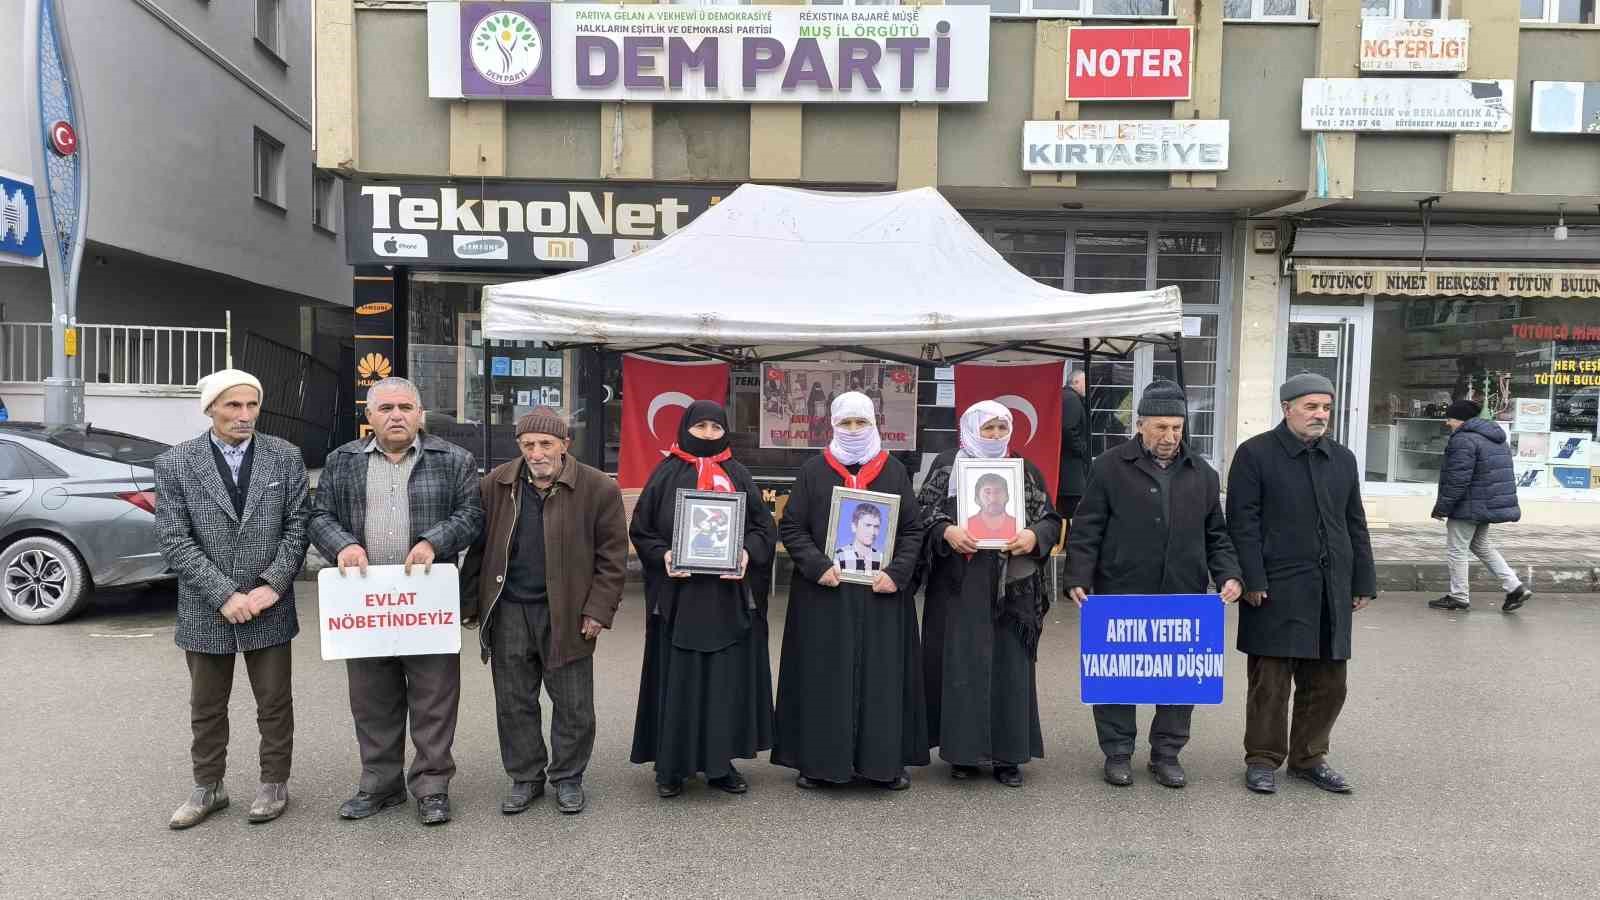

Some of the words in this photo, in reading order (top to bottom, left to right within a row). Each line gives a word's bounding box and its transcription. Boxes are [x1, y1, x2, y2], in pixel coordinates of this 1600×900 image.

[615, 11, 645, 20] GELAN
[576, 24, 629, 33] HALKLARIN
[631, 23, 666, 35] EŞİTLİK
[668, 25, 679, 33] VE
[681, 23, 733, 34] DEMOKRASİ
[736, 23, 772, 34] PARTİSİ
[799, 25, 832, 38] MUŞ
[836, 23, 849, 37] İL
[854, 23, 920, 37] ÖRGÜTÜ
[576, 35, 719, 89] DEM
[742, 20, 951, 90] PARTİ
[1076, 48, 1184, 78] NOTER
[486, 69, 503, 80] DEM
[1028, 140, 1225, 165] KIRTASİYE
[361, 185, 690, 237] TeknoNet
[1311, 271, 1374, 290] TÜTÜNCÜ
[1385, 271, 1428, 290] NİMET
[1507, 273, 1553, 291] TÜTÜN
[1554, 360, 1576, 372] HER
[1535, 372, 1570, 385] TÜTÜN
[364, 591, 417, 608] EVLAT
[328, 608, 454, 631] NÖBETİNDEYİZ
[1106, 618, 1148, 643] ARTIK
[1150, 618, 1192, 643] YETER
[1082, 653, 1173, 678] YAKAMIZDAN
[1176, 647, 1224, 685] DÜŞÜN
